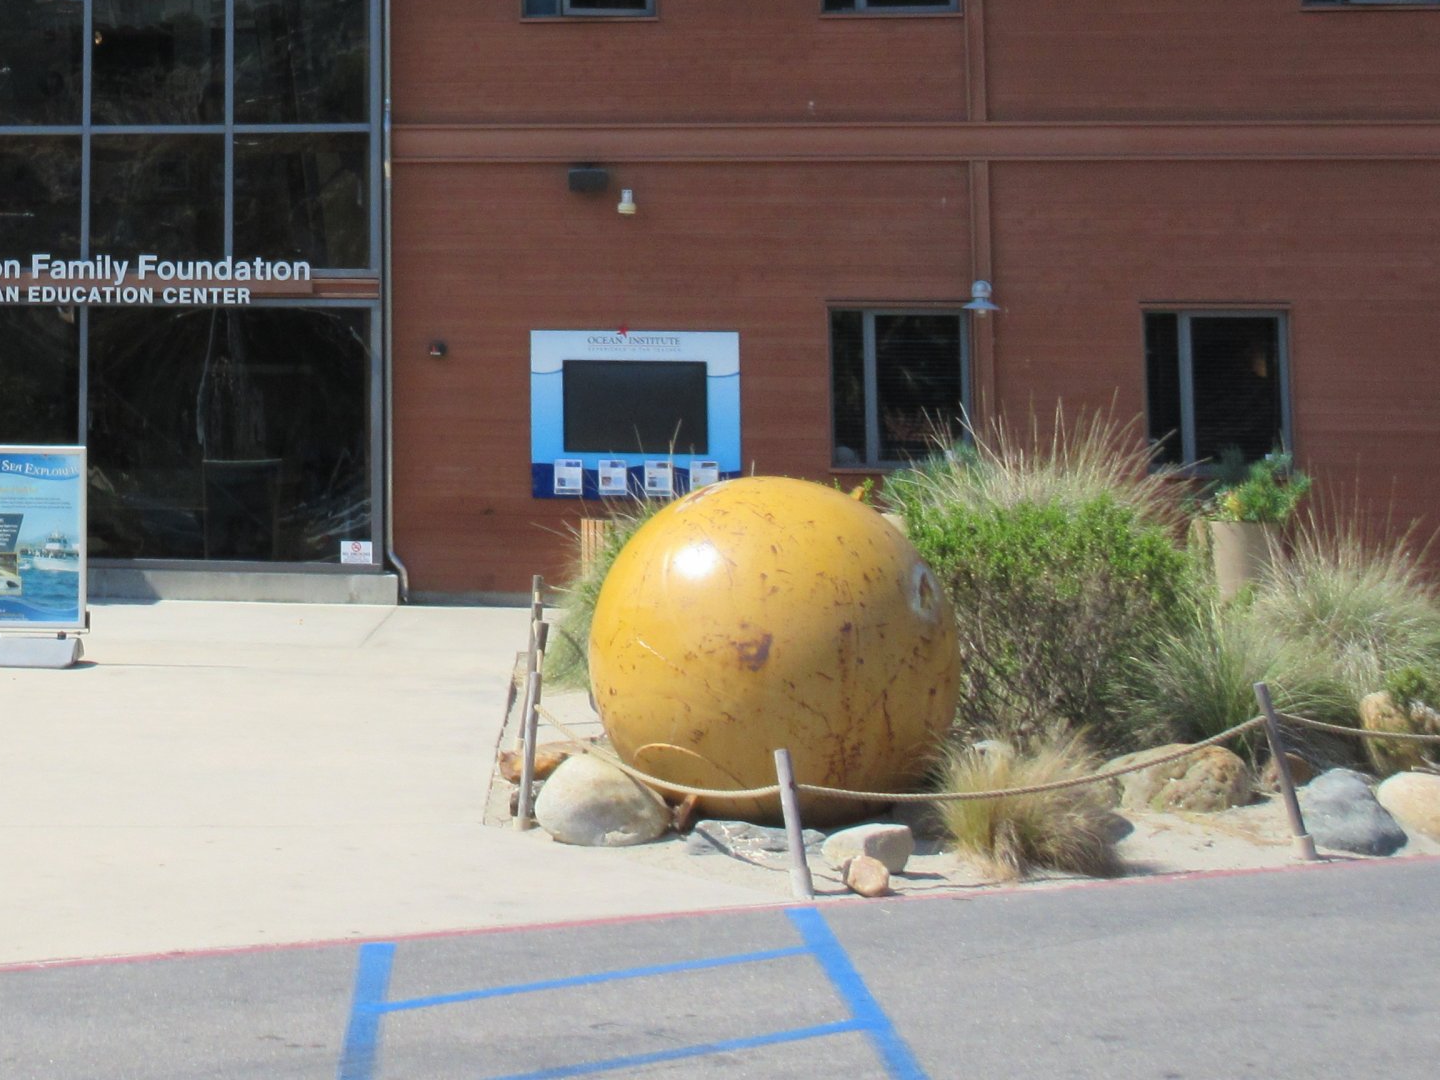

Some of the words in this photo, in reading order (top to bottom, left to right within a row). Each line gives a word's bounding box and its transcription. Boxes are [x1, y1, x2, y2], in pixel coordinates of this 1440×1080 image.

[31, 254, 128, 286] Family
[138, 255, 311, 281] Foundation
[27, 286, 153, 304] EDUCATION
[162, 287, 251, 305] CENTER
[587, 336, 623, 345] OCEAN
[629, 336, 681, 345] INSTITUTE
